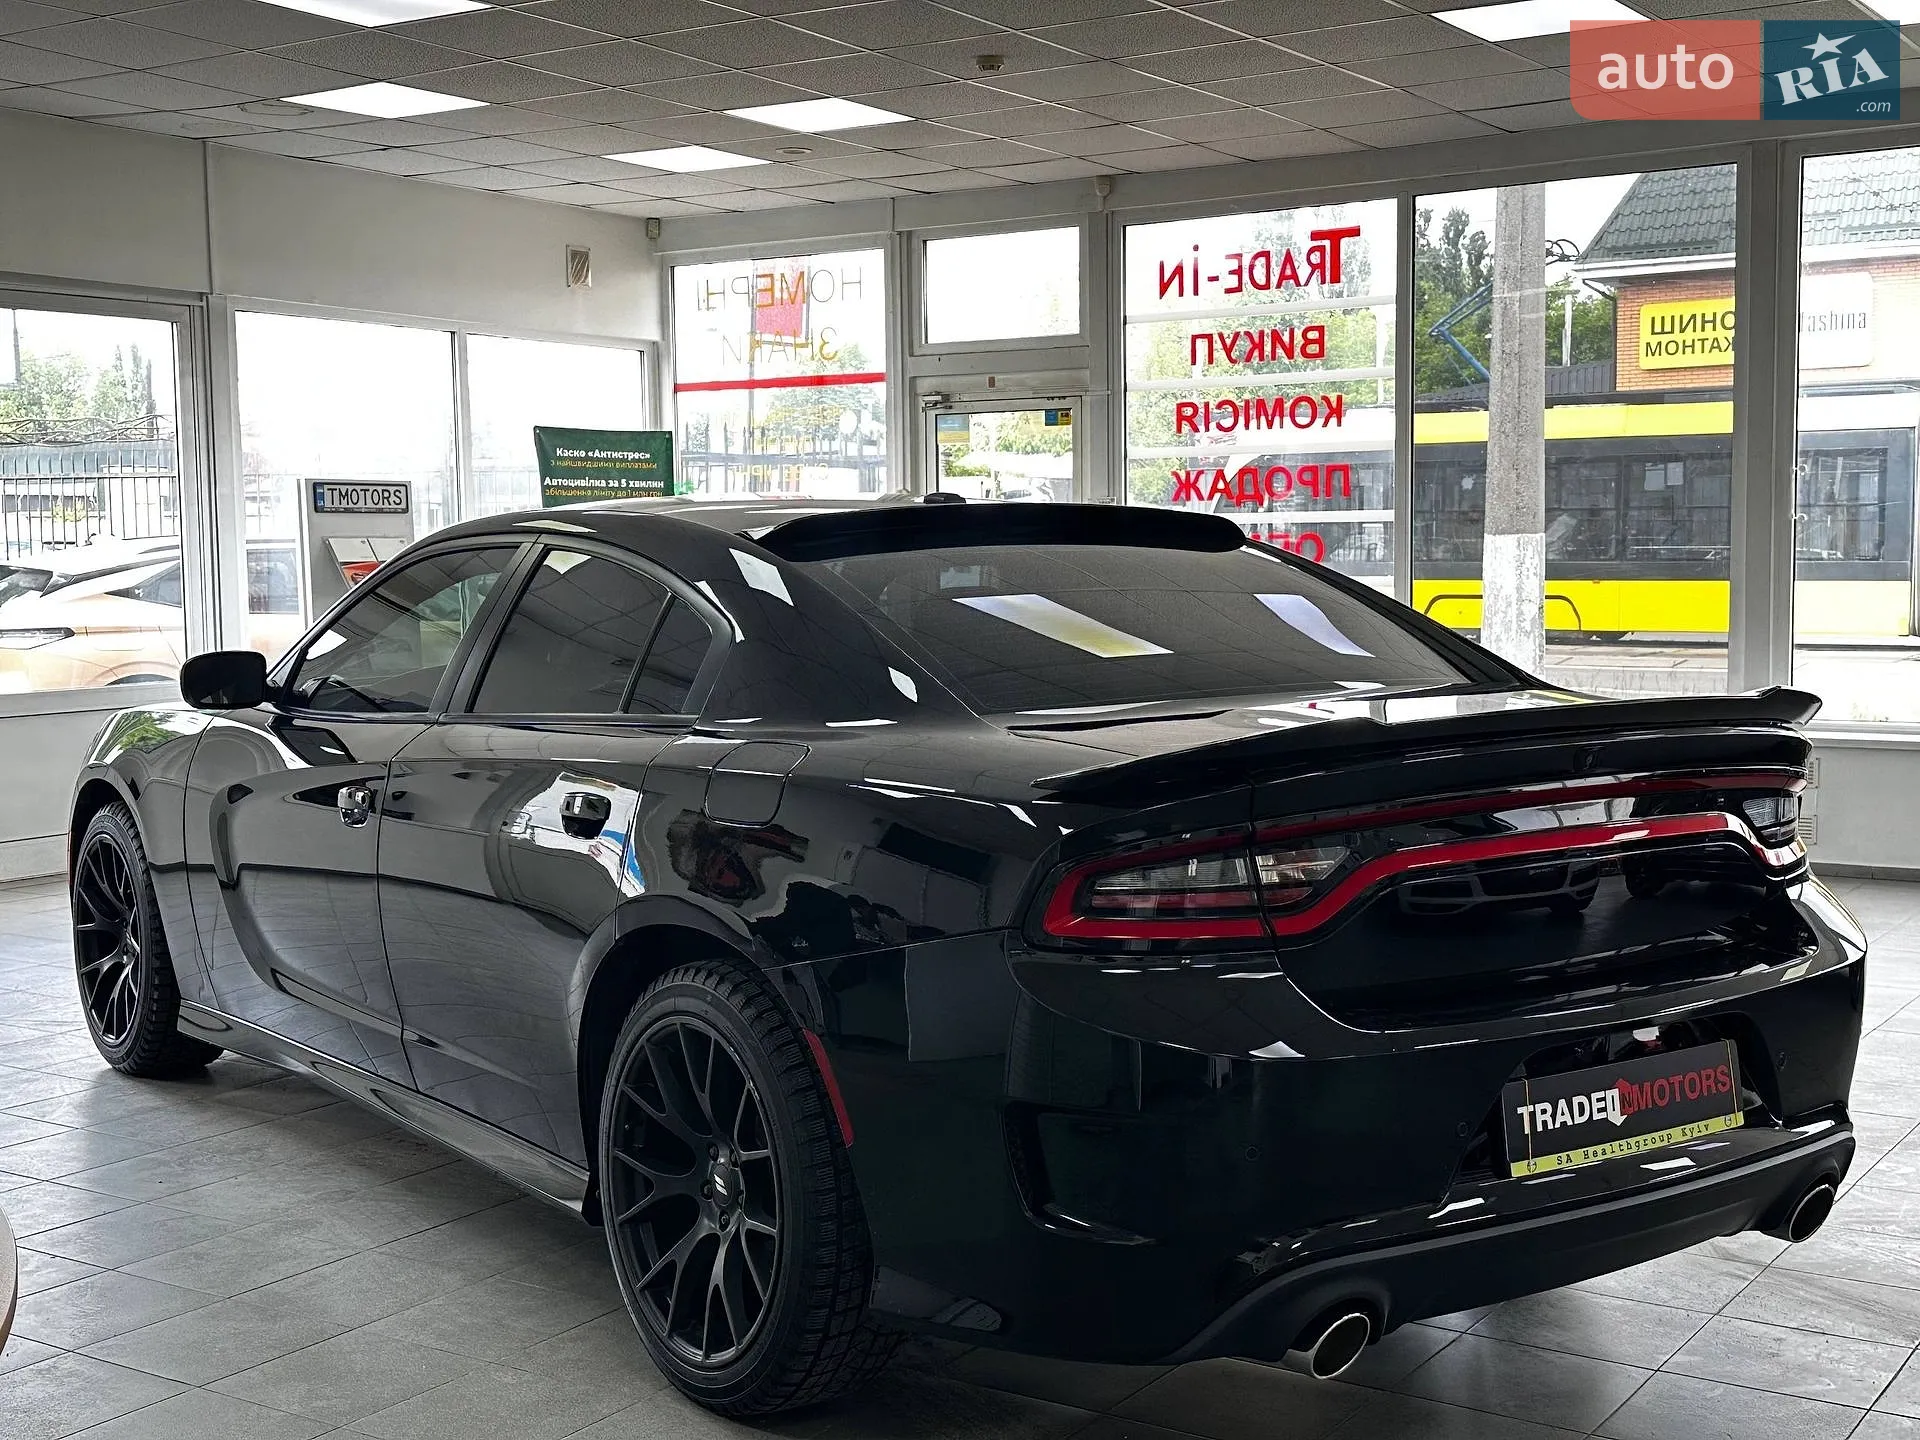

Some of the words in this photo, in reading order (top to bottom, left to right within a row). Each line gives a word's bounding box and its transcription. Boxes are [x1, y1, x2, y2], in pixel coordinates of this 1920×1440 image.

[1801, 310, 1867, 333] ashina
[556, 447, 586, 458] Каско
[588, 449, 651, 461] «Антистрес»
[543, 476, 607, 488] Автоцивілка
[608, 479, 618, 488] за
[620, 478, 627, 488] 5
[628, 479, 665, 489] хвилин
[326, 487, 403, 506] TMOTORS
[1556, 1154, 1574, 1166] SA
[1582, 1132, 1674, 1160] Healthgroup
[1681, 1121, 1711, 1142] Kyiv
